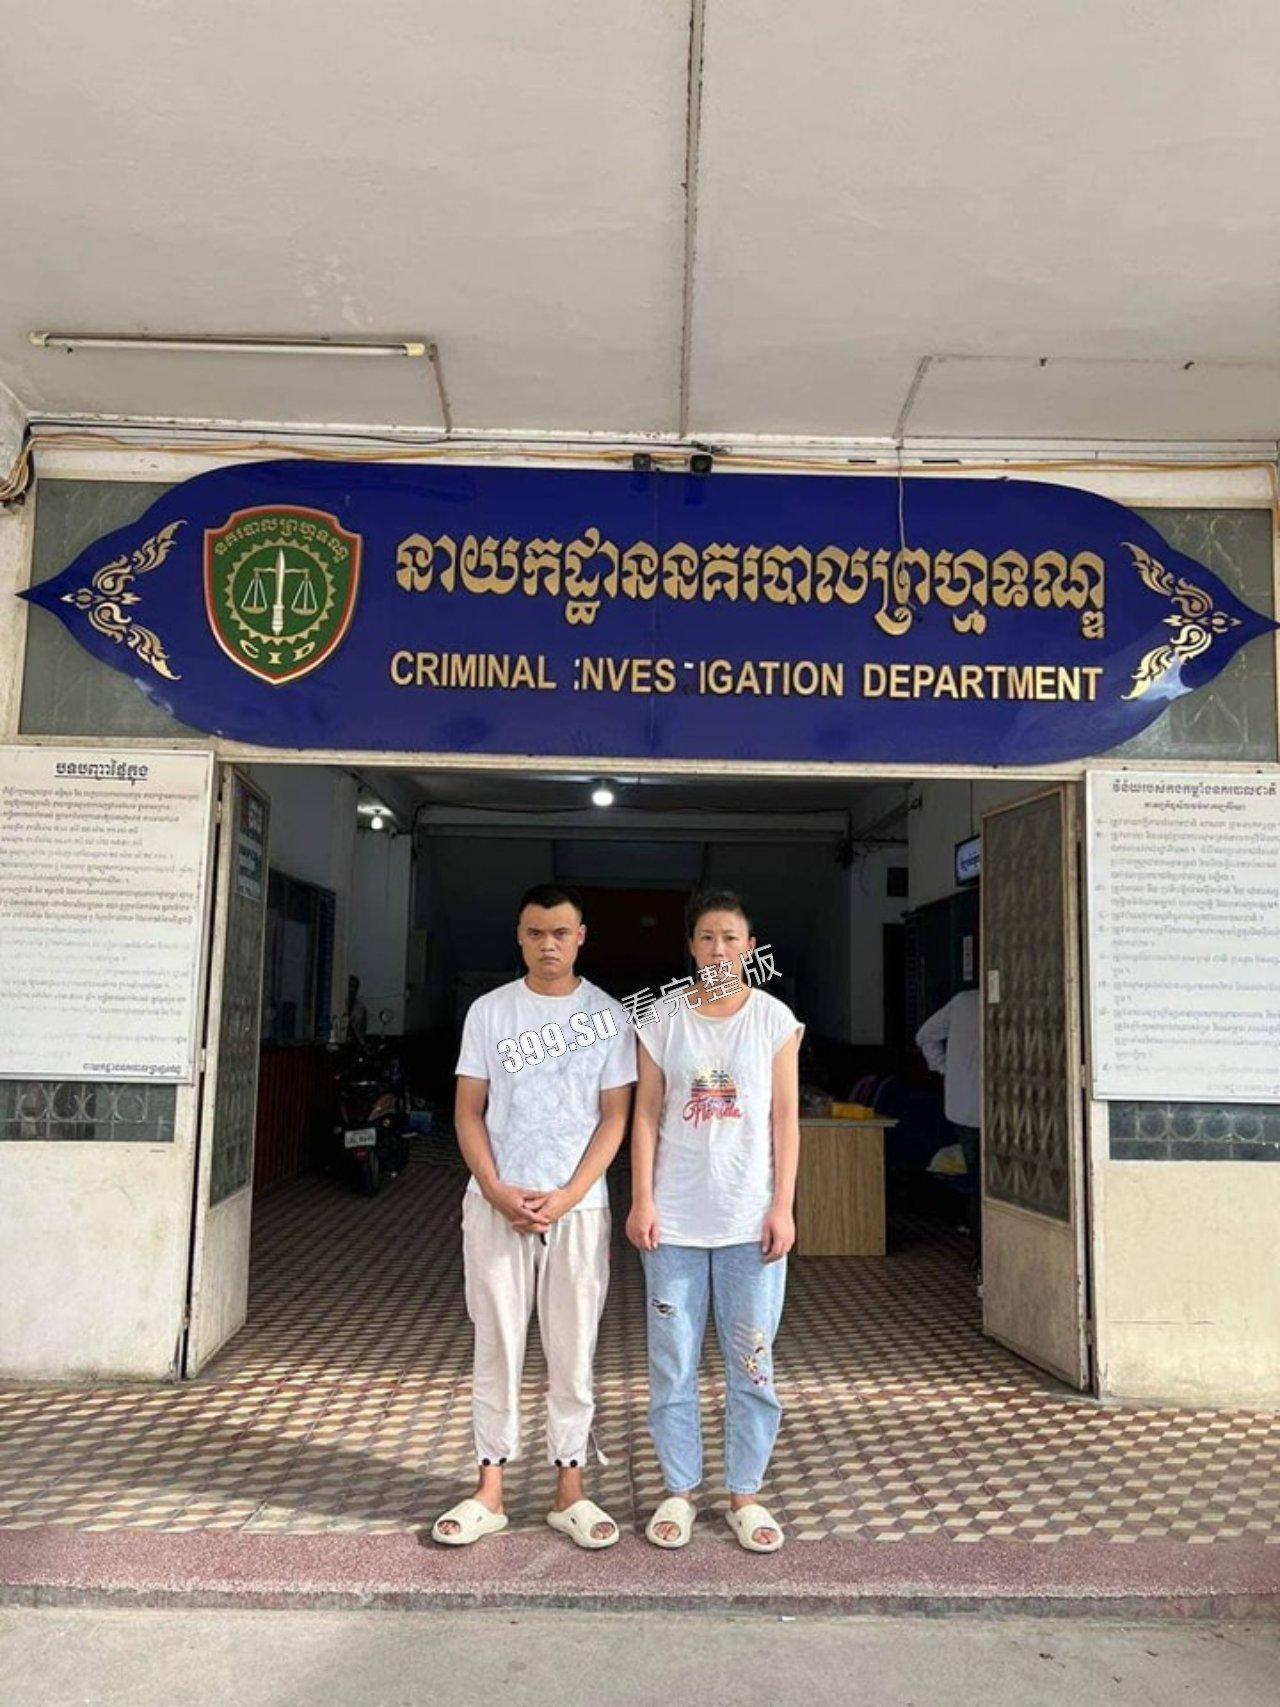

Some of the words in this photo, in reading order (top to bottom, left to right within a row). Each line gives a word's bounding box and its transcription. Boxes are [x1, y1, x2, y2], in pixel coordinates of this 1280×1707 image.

[239, 639, 316, 664] CID
[390, 651, 556, 689] CRIMINAL
[863, 663, 1104, 701] DEPARTMENT
